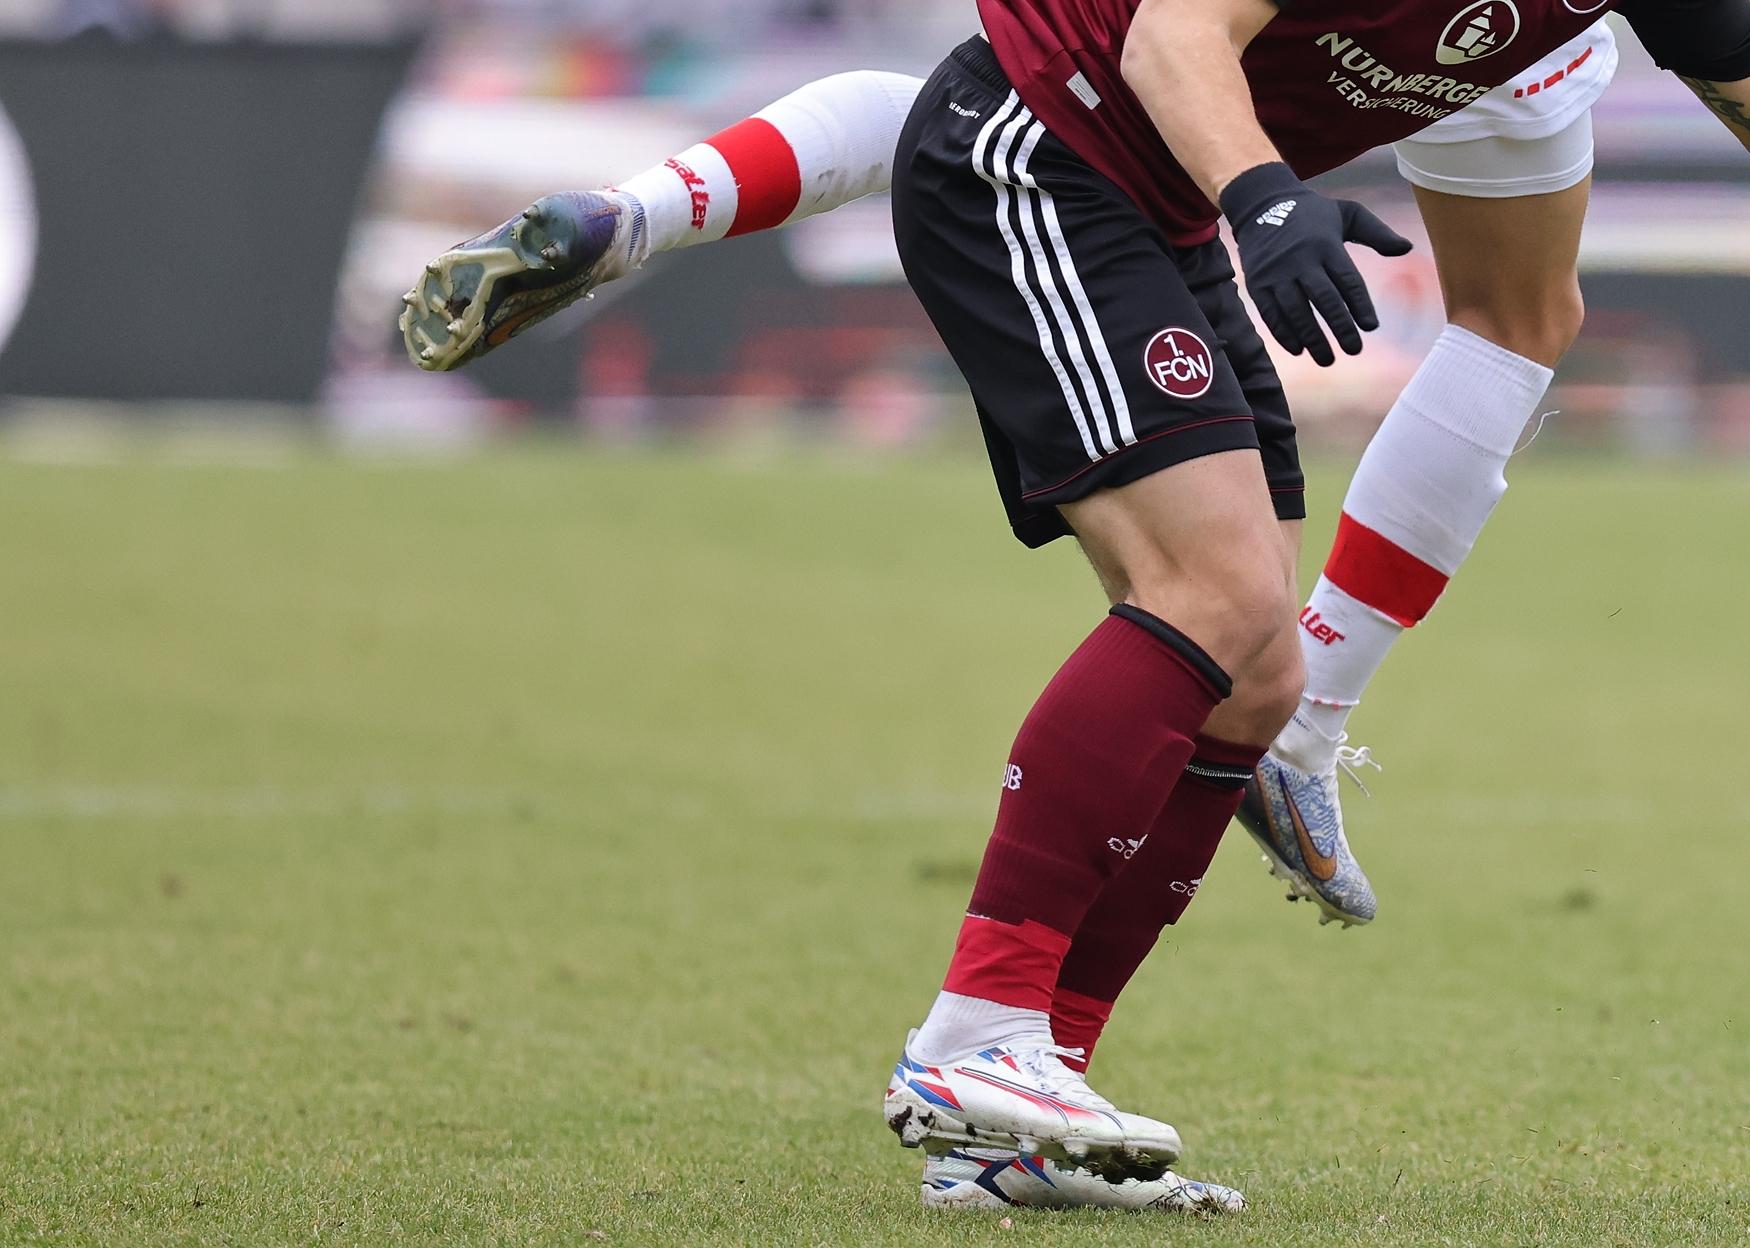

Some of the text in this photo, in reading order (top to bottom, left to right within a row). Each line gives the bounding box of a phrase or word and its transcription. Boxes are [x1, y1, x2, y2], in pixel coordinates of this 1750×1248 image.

[1315, 32, 1493, 105] NÜRNBERGE
[1153, 353, 1209, 386] FCN
[1299, 606, 1346, 646] ller
